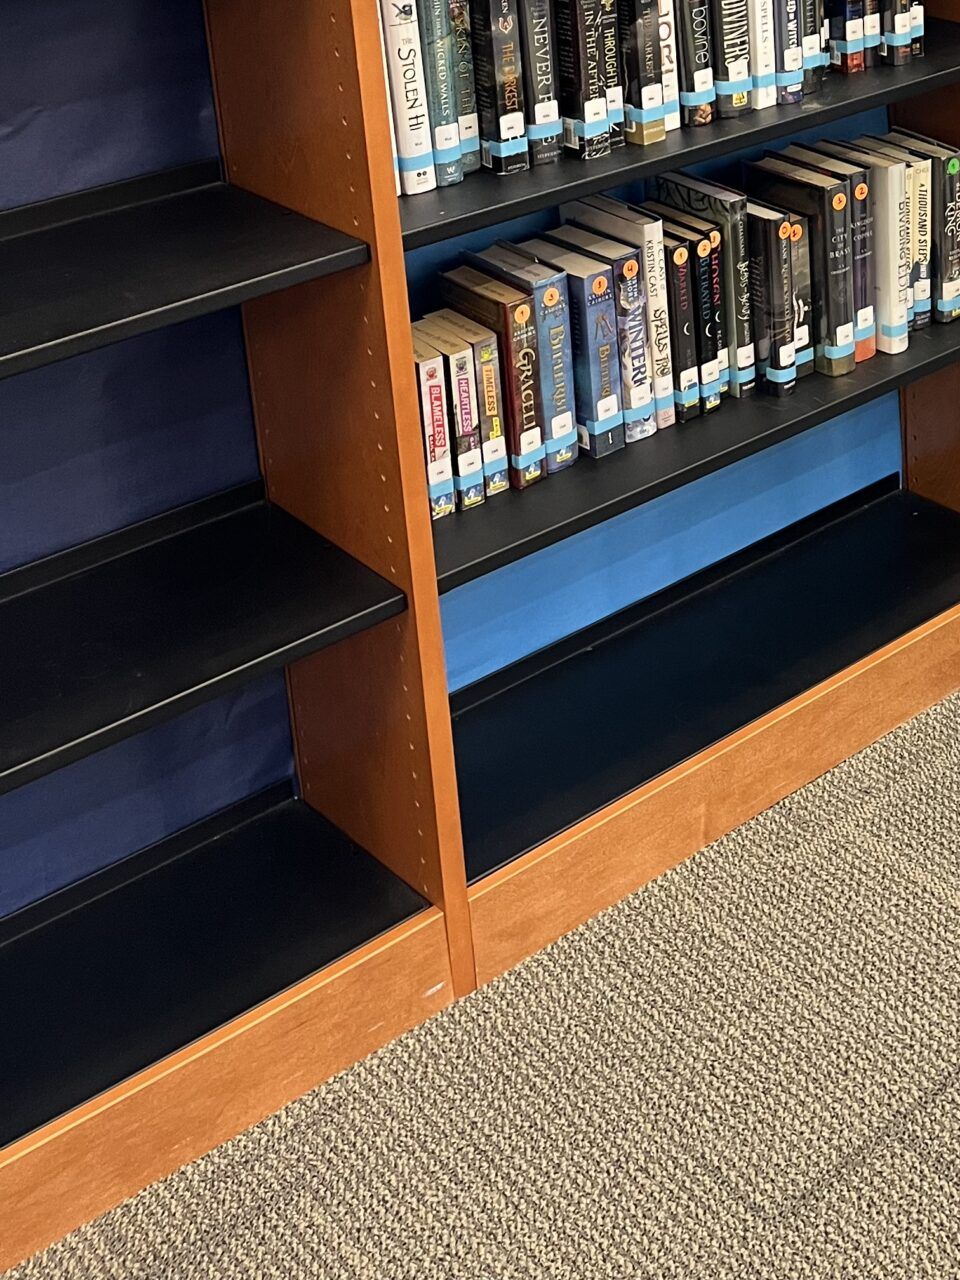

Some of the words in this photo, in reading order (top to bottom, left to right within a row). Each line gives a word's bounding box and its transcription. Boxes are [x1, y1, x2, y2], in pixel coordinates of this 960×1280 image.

[585, 11, 594, 25] IN
[692, 4, 711, 64] bovine
[760, 1, 769, 44] SPELLS
[436, 38, 448, 80] WICKED
[502, 41, 515, 63] THE
[533, 17, 552, 89] NEVER
[585, 28, 597, 56] THE
[603, 27, 617, 76] THROUGH
[397, 47, 422, 110] STOLEN
[439, 82, 450, 116] WALLS
[898, 201, 906, 260] DIVIDING
[918, 188, 928, 238] THOUSAND
[945, 201, 957, 237] KING
[646, 240, 656, 274] KRISTIN
[918, 238, 928, 264] STEPS
[648, 275, 658, 298] CAST
[677, 262, 689, 312] MARKED
[699, 257, 712, 320] BETRAYED
[652, 309, 670, 353] SPELLS
[459, 379, 472, 433] HEARTLESS
[485, 369, 496, 412] TIMELESS
[430, 385, 445, 446] BLAMELESS
